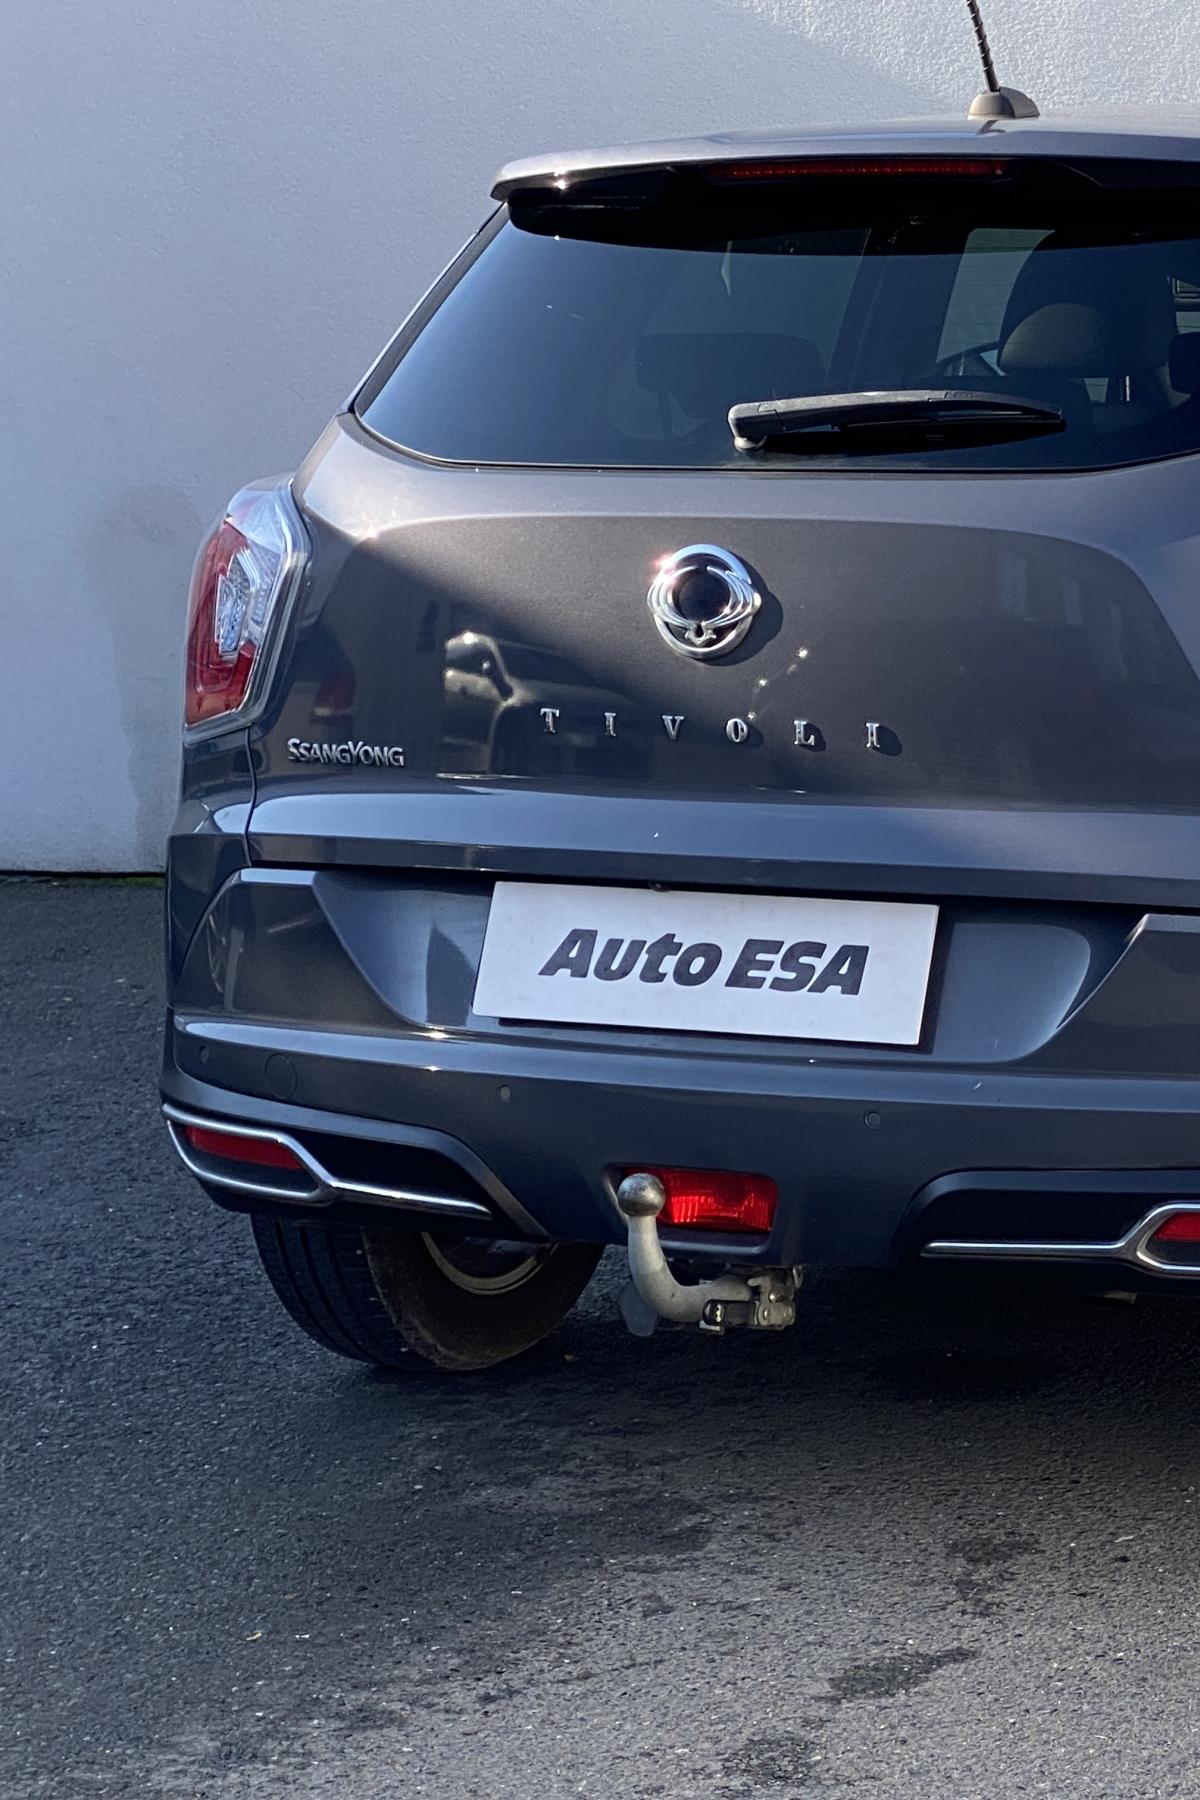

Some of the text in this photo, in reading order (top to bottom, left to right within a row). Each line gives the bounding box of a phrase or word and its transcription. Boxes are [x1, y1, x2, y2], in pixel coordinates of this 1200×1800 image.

[540, 708, 881, 749] TIVOLI
[538, 928, 870, 996] Auto ESA
